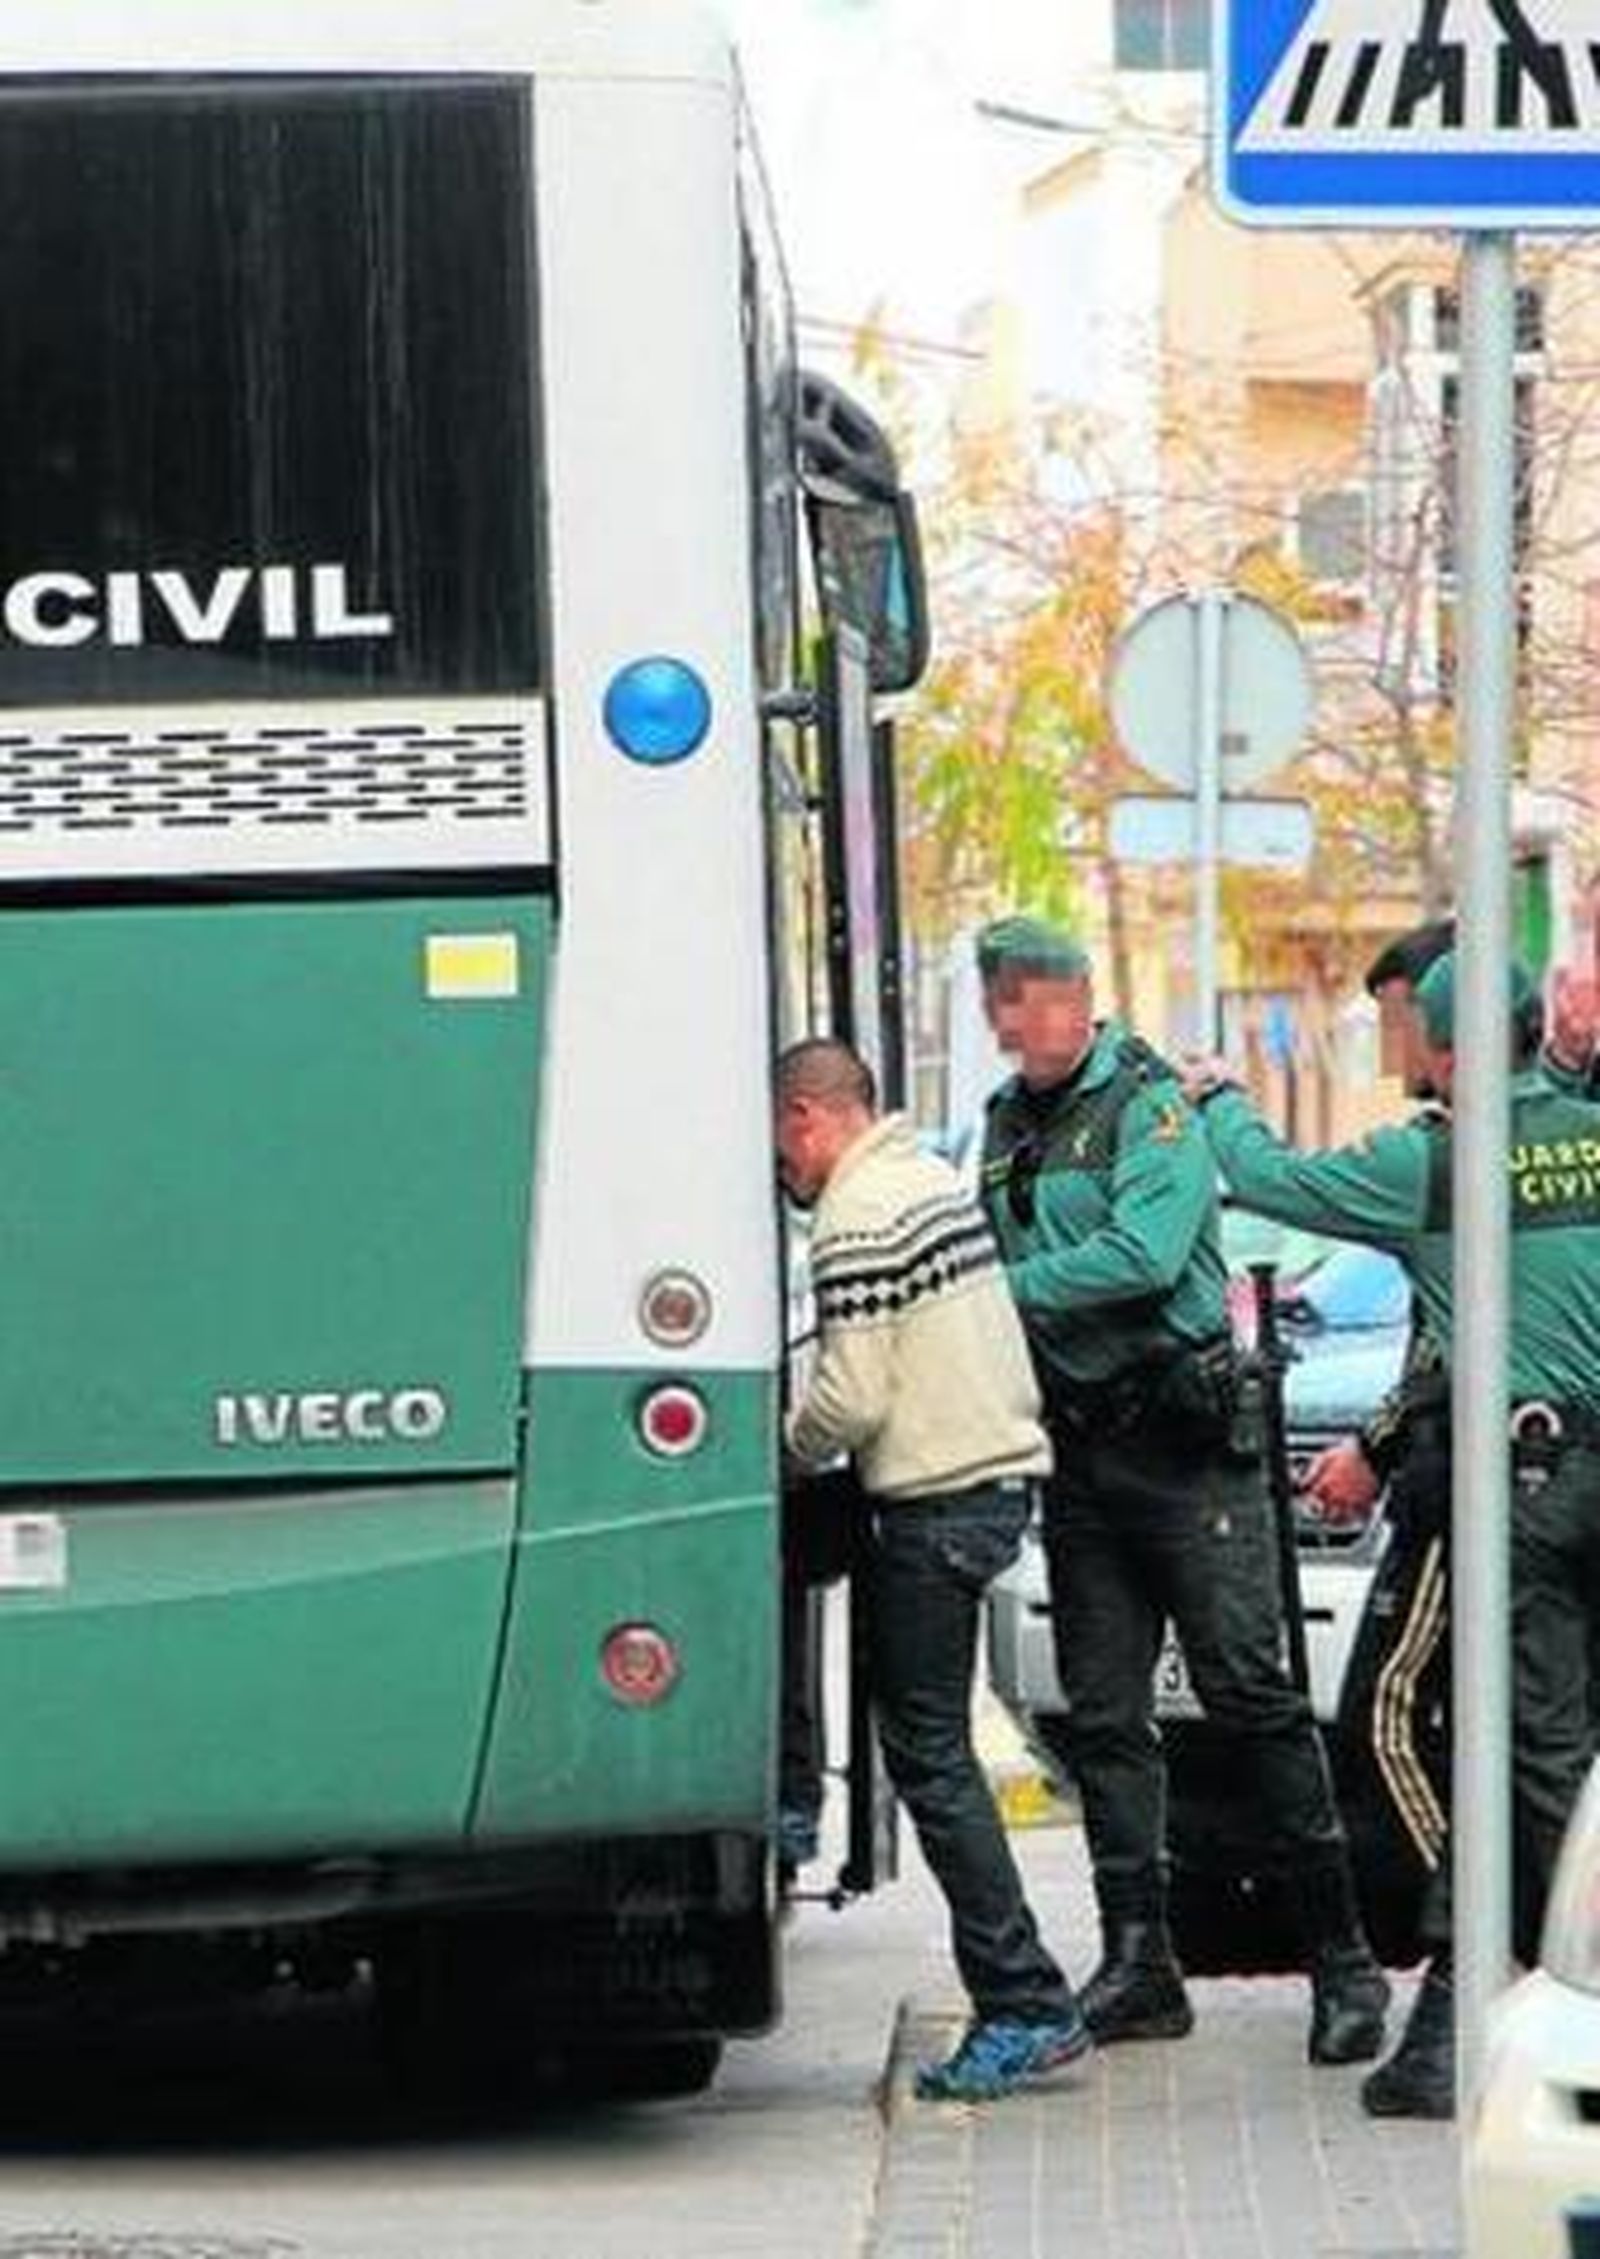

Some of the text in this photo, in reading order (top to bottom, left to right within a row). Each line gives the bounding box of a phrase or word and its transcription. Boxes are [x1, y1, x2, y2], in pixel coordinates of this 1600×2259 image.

[5, 563, 393, 646] CIVIL
[1521, 1170, 1600, 1203] CIVI
[216, 1389, 446, 1443] IVECO
